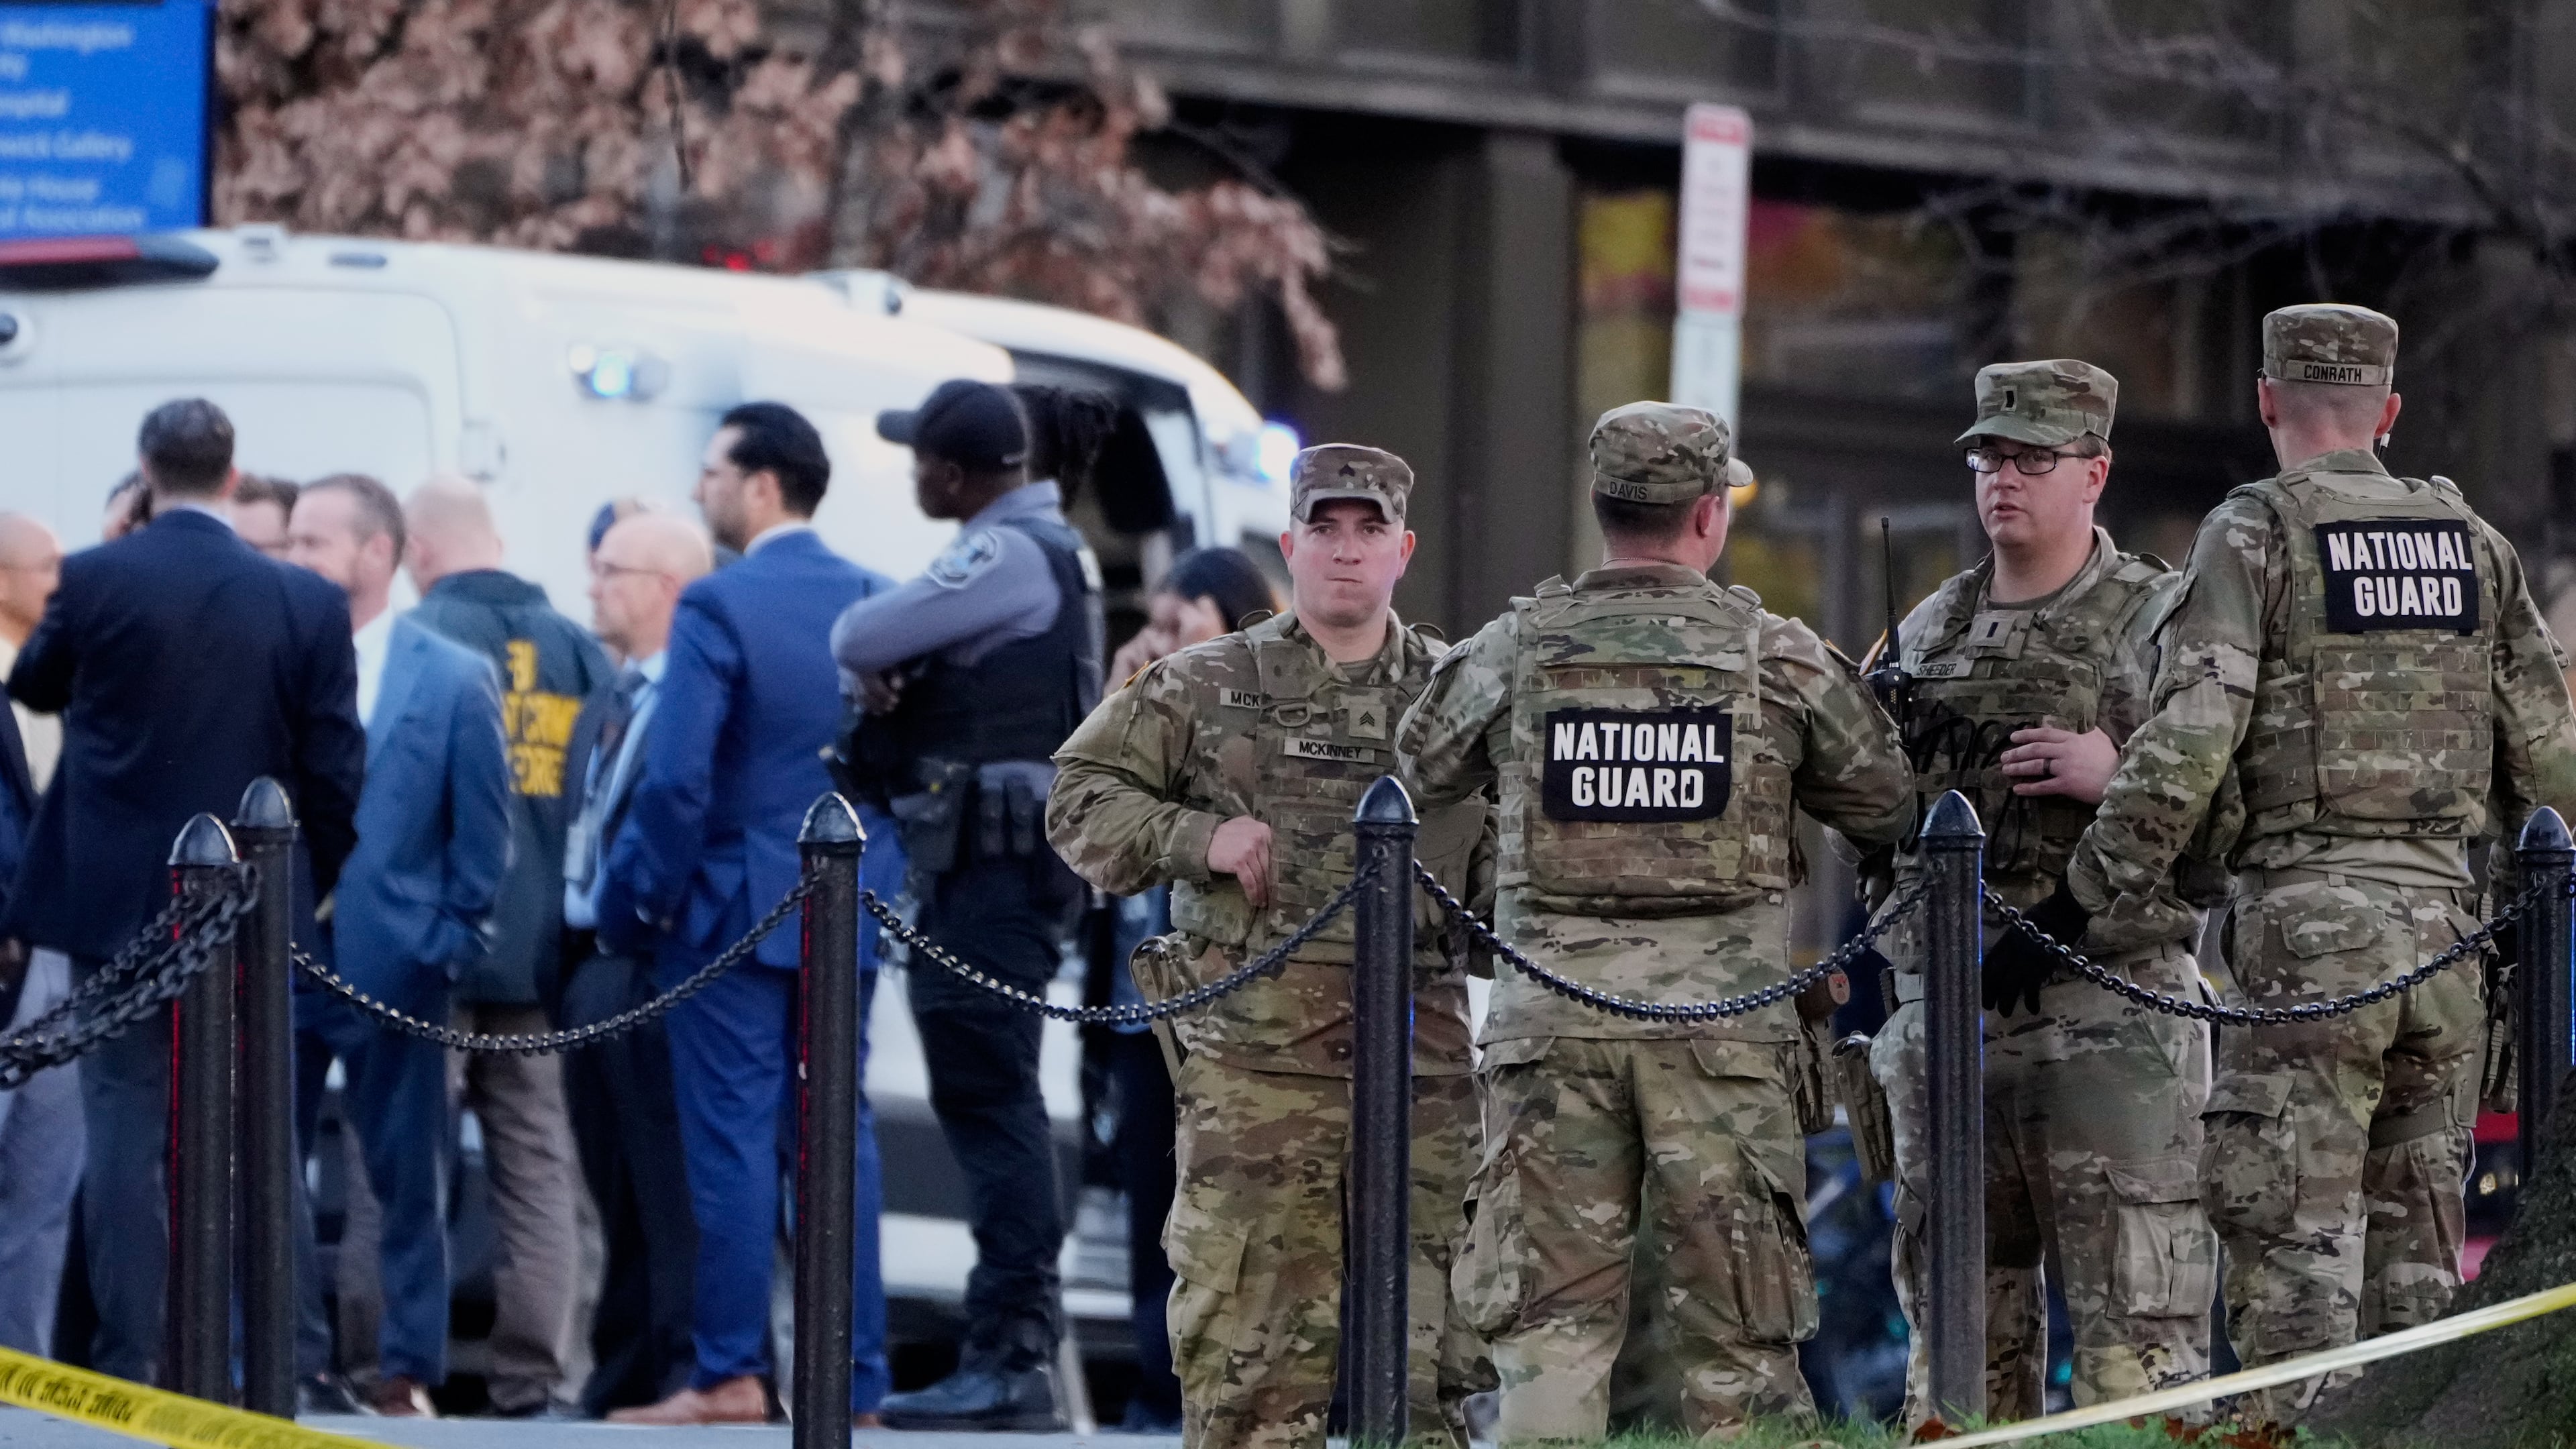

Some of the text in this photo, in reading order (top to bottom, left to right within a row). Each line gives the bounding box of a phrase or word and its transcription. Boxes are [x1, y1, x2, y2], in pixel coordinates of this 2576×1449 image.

[2304, 364, 2362, 383] CONRATH
[1610, 481, 1648, 500] DAVIS
[2327, 531, 2472, 571] NATIONAL
[2353, 577, 2463, 616] GUARD
[1299, 741, 1361, 759] MCKINNEY
[1553, 722, 1724, 763] NATIONAL
[1571, 767, 1705, 808] GUARD
